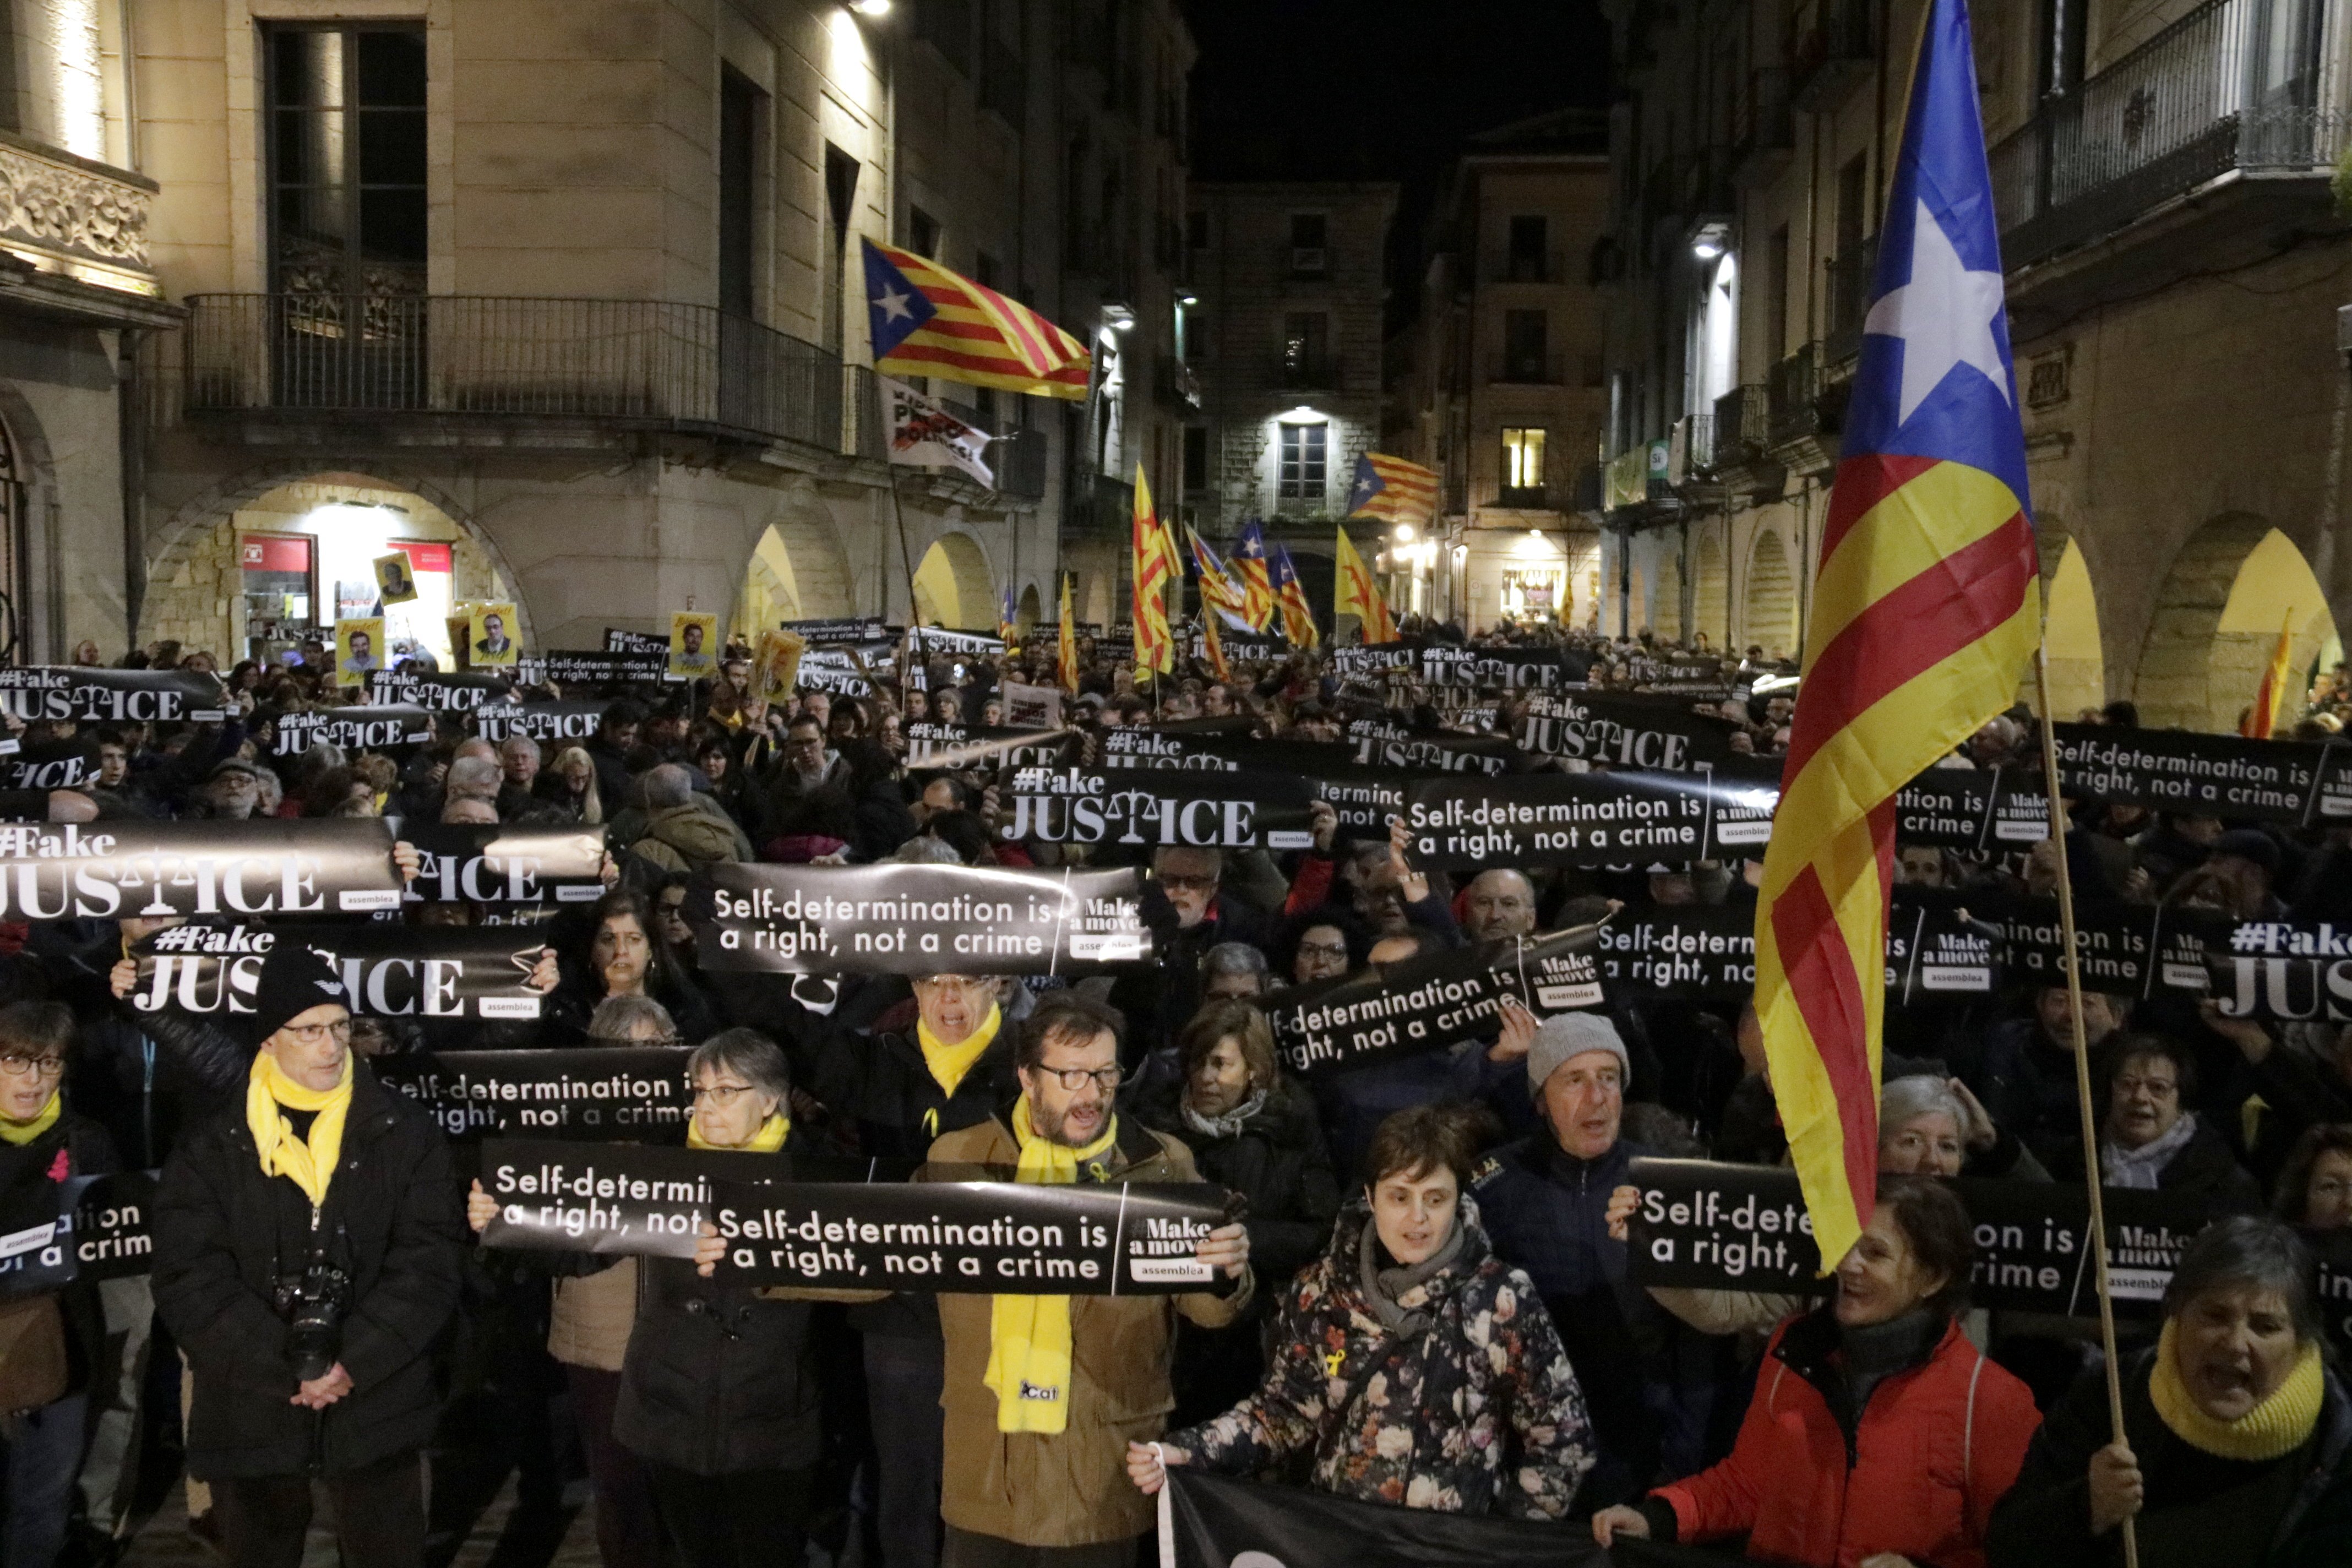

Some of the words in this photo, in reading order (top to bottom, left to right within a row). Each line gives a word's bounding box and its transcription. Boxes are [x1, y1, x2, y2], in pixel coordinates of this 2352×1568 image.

[1333, 647, 1366, 656] #Fake
[1422, 647, 1476, 661] #Fake
[551, 671, 559, 679] a
[563, 668, 591, 682] right,
[650, 658, 660, 669] is
[1419, 658, 1560, 688] JUSTICE
[373, 671, 419, 685] #Fake
[369, 682, 487, 711] JUSTICE
[1529, 696, 1589, 720] #Fake
[279, 711, 327, 728] #Fake
[477, 703, 525, 718] #Fake
[273, 718, 402, 756] JUSTICE
[908, 723, 967, 740] #Fake
[1349, 719, 1408, 742] #Fake
[1105, 732, 1182, 756] #Fake
[1516, 716, 1689, 771] JUSTICE
[2053, 738, 2278, 782] Self-determination
[2289, 762, 2309, 786] is
[1012, 767, 1105, 796] #Fake
[2076, 766, 2140, 795] right,
[2152, 777, 2192, 797] not
[2201, 784, 2217, 800] a
[2228, 783, 2301, 810] crime
[1411, 794, 1669, 827] Self-determination
[1680, 792, 1701, 816] is
[1964, 790, 1983, 813] is
[1997, 807, 2007, 818] a
[1001, 788, 1256, 845] JUSTICE
[1340, 808, 1375, 825] not
[1716, 808, 1728, 820] a
[1904, 812, 1974, 835] crime
[0, 824, 116, 859] #Fake
[1273, 835, 1309, 844] assemblea
[1419, 837, 1436, 853] a
[1447, 825, 1522, 860] right,
[1534, 826, 1578, 849] not
[1590, 829, 1607, 847] a
[1619, 820, 1695, 846] crime
[1725, 827, 1770, 836] assemblea
[347, 895, 394, 904] assemblea
[562, 889, 601, 897] assemblea
[714, 888, 1012, 922] Self-determination
[1028, 894, 1051, 922] is
[1085, 897, 1140, 916] Make
[1070, 917, 1083, 930] a
[1085, 917, 1140, 932] move
[154, 924, 276, 954] #Fake
[720, 929, 739, 949] a
[754, 921, 839, 959] right,
[854, 928, 907, 952] not
[920, 932, 939, 952] a
[954, 925, 1043, 955] crime
[1938, 933, 1991, 951] Make
[2122, 927, 2145, 952] is
[1541, 952, 1594, 976] Make
[1922, 950, 1935, 963] a
[1937, 950, 1991, 965] move
[2027, 951, 2044, 969] a
[133, 944, 464, 1014] JUSICE
[1488, 966, 1515, 987] is
[1532, 974, 1545, 985] a
[1547, 967, 1597, 985] move
[1632, 953, 1709, 988] right,
[1724, 963, 1755, 982] no
[1931, 973, 1983, 982] assemblea
[1547, 989, 1595, 1001] assemblea
[487, 1002, 533, 1012] assemblea
[1353, 1021, 1398, 1052] not
[1408, 1020, 1427, 1038] a
[1437, 992, 1516, 1030] crime
[429, 1101, 506, 1135] ight,
[520, 1104, 568, 1126] not
[582, 1108, 601, 1126] a
[496, 1164, 712, 1204] Self-determi
[503, 1204, 524, 1226] a
[538, 1197, 631, 1237] right,
[646, 1207, 701, 1235] not
[718, 1208, 1062, 1246] Self-determination
[1080, 1215, 1107, 1248] is
[1146, 1216, 1211, 1239] Make
[2043, 1217, 2073, 1253] is
[40, 1245, 62, 1267] a
[78, 1229, 152, 1262] crim
[1129, 1240, 1145, 1255] a
[1651, 1242, 1674, 1262] a
[1693, 1232, 1799, 1277] right,
[733, 1248, 756, 1267] a
[771, 1242, 867, 1278] right,
[884, 1250, 943, 1275] not
[958, 1256, 981, 1276] a
[997, 1249, 1100, 1278] crime
[1141, 1265, 1204, 1276] assemblea
